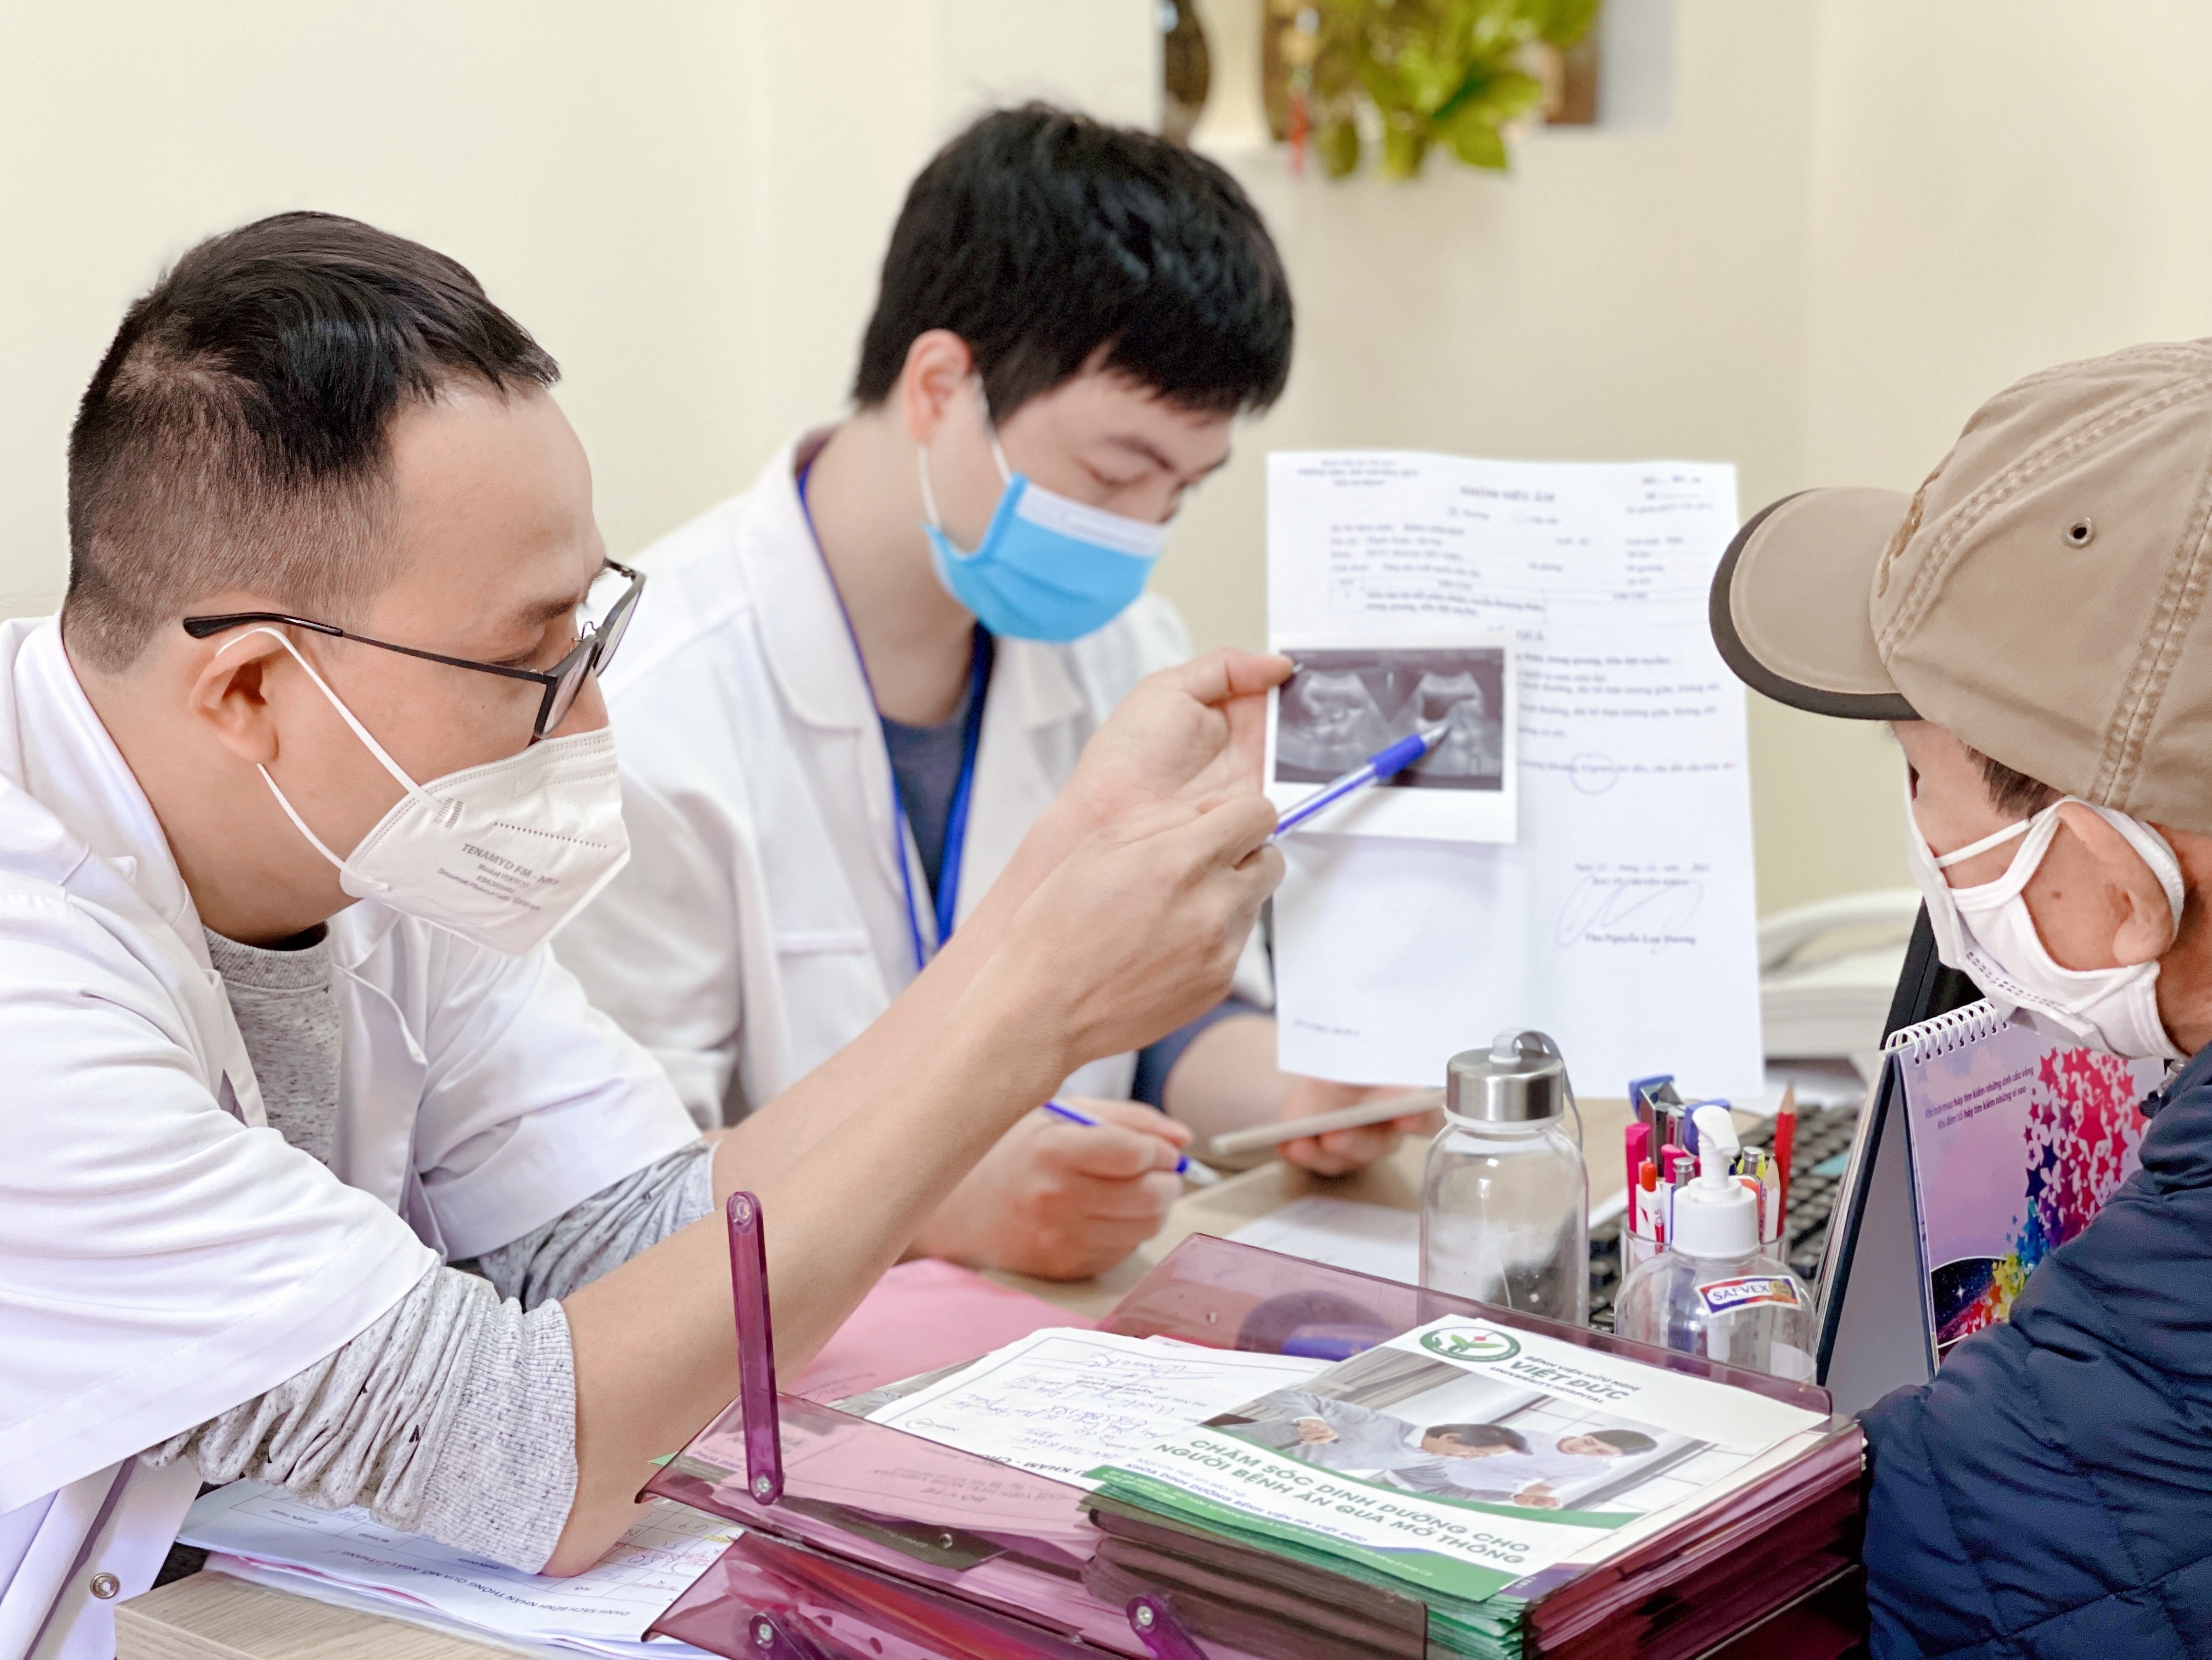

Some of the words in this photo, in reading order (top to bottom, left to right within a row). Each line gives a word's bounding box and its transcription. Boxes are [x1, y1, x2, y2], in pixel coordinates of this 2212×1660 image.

[462, 843, 514, 870] TENAMYD
[514, 866, 533, 877] FM
[1712, 1285, 1770, 1301] SAFVEX
[1489, 1366, 1555, 1389] UNIVERSITY
[1551, 1384, 1604, 1404] HOSPITAL
[1510, 1361, 1571, 1382] VIỆT
[1566, 1379, 1629, 1400] ĐỨC
[1125, 1462, 1157, 1475] KHOA
[1159, 1472, 1189, 1485] DINH
[1188, 1484, 1233, 1502] DƯỠNG
[1233, 1499, 1265, 1513] BỆNH
[1267, 1510, 1293, 1521] VIỆN
[1293, 1517, 1313, 1526] HN
[1153, 1443, 1231, 1471] NGƯỜI
[1230, 1468, 1294, 1494] BỆNH
[1293, 1490, 1334, 1507] ĂN
[1335, 1504, 1385, 1524] QUA
[1389, 1520, 1437, 1537] MỞ
[1436, 1534, 1526, 1564] THÔNG
[1190, 1440, 1262, 1467] CHĂM
[1262, 1465, 1314, 1486] SÓC
[1315, 1484, 1377, 1507] DINH
[1376, 1503, 1468, 1535] DƯỠNG
[1472, 1532, 1531, 1552] CHO
[443, 1574, 467, 1584] QUA
[467, 1581, 506, 1599] THÔNG
